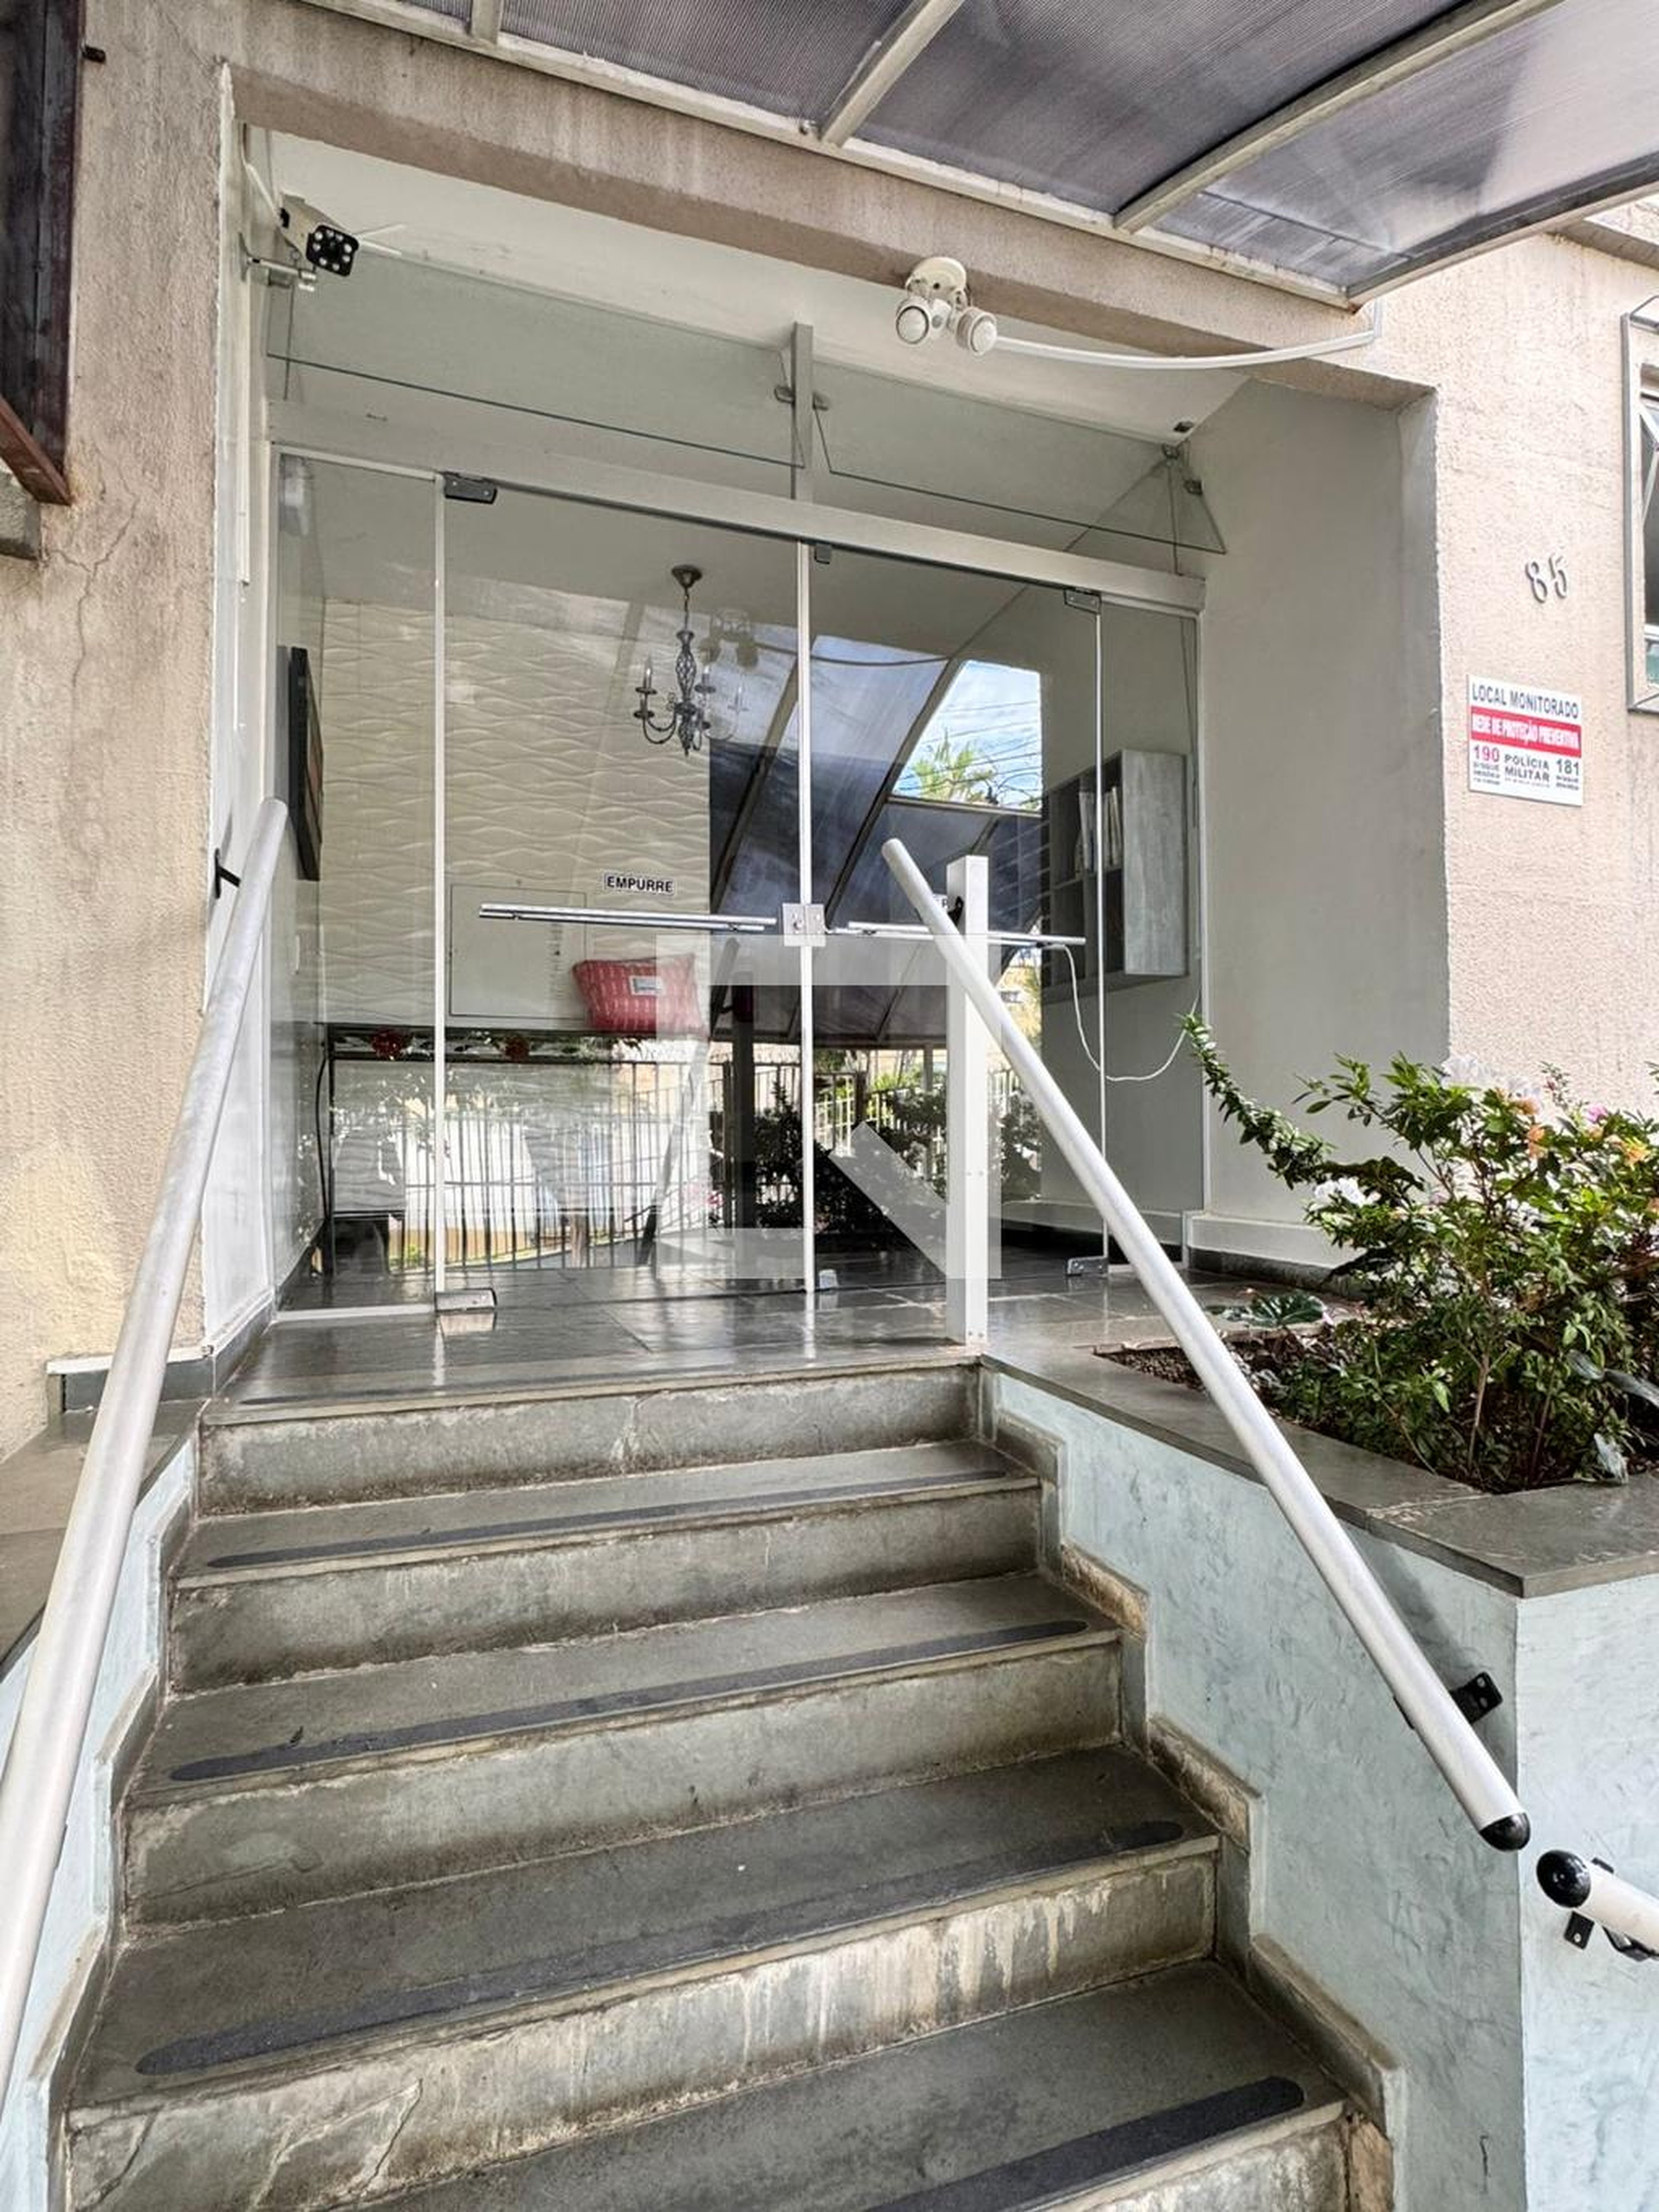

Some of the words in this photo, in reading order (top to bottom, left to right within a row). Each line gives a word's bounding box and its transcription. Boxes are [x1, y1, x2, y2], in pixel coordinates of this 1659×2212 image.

[1524, 552, 1567, 603] 85
[1472, 682, 1506, 705] LOCAL
[1510, 690, 1579, 719] MONITORADO
[1474, 745, 1500, 762] 190
[1504, 754, 1549, 770] POLÍCIA
[1504, 766, 1550, 783] MILITAR
[1556, 758, 1579, 776] 181
[607, 875, 674, 893] EMPURRE
